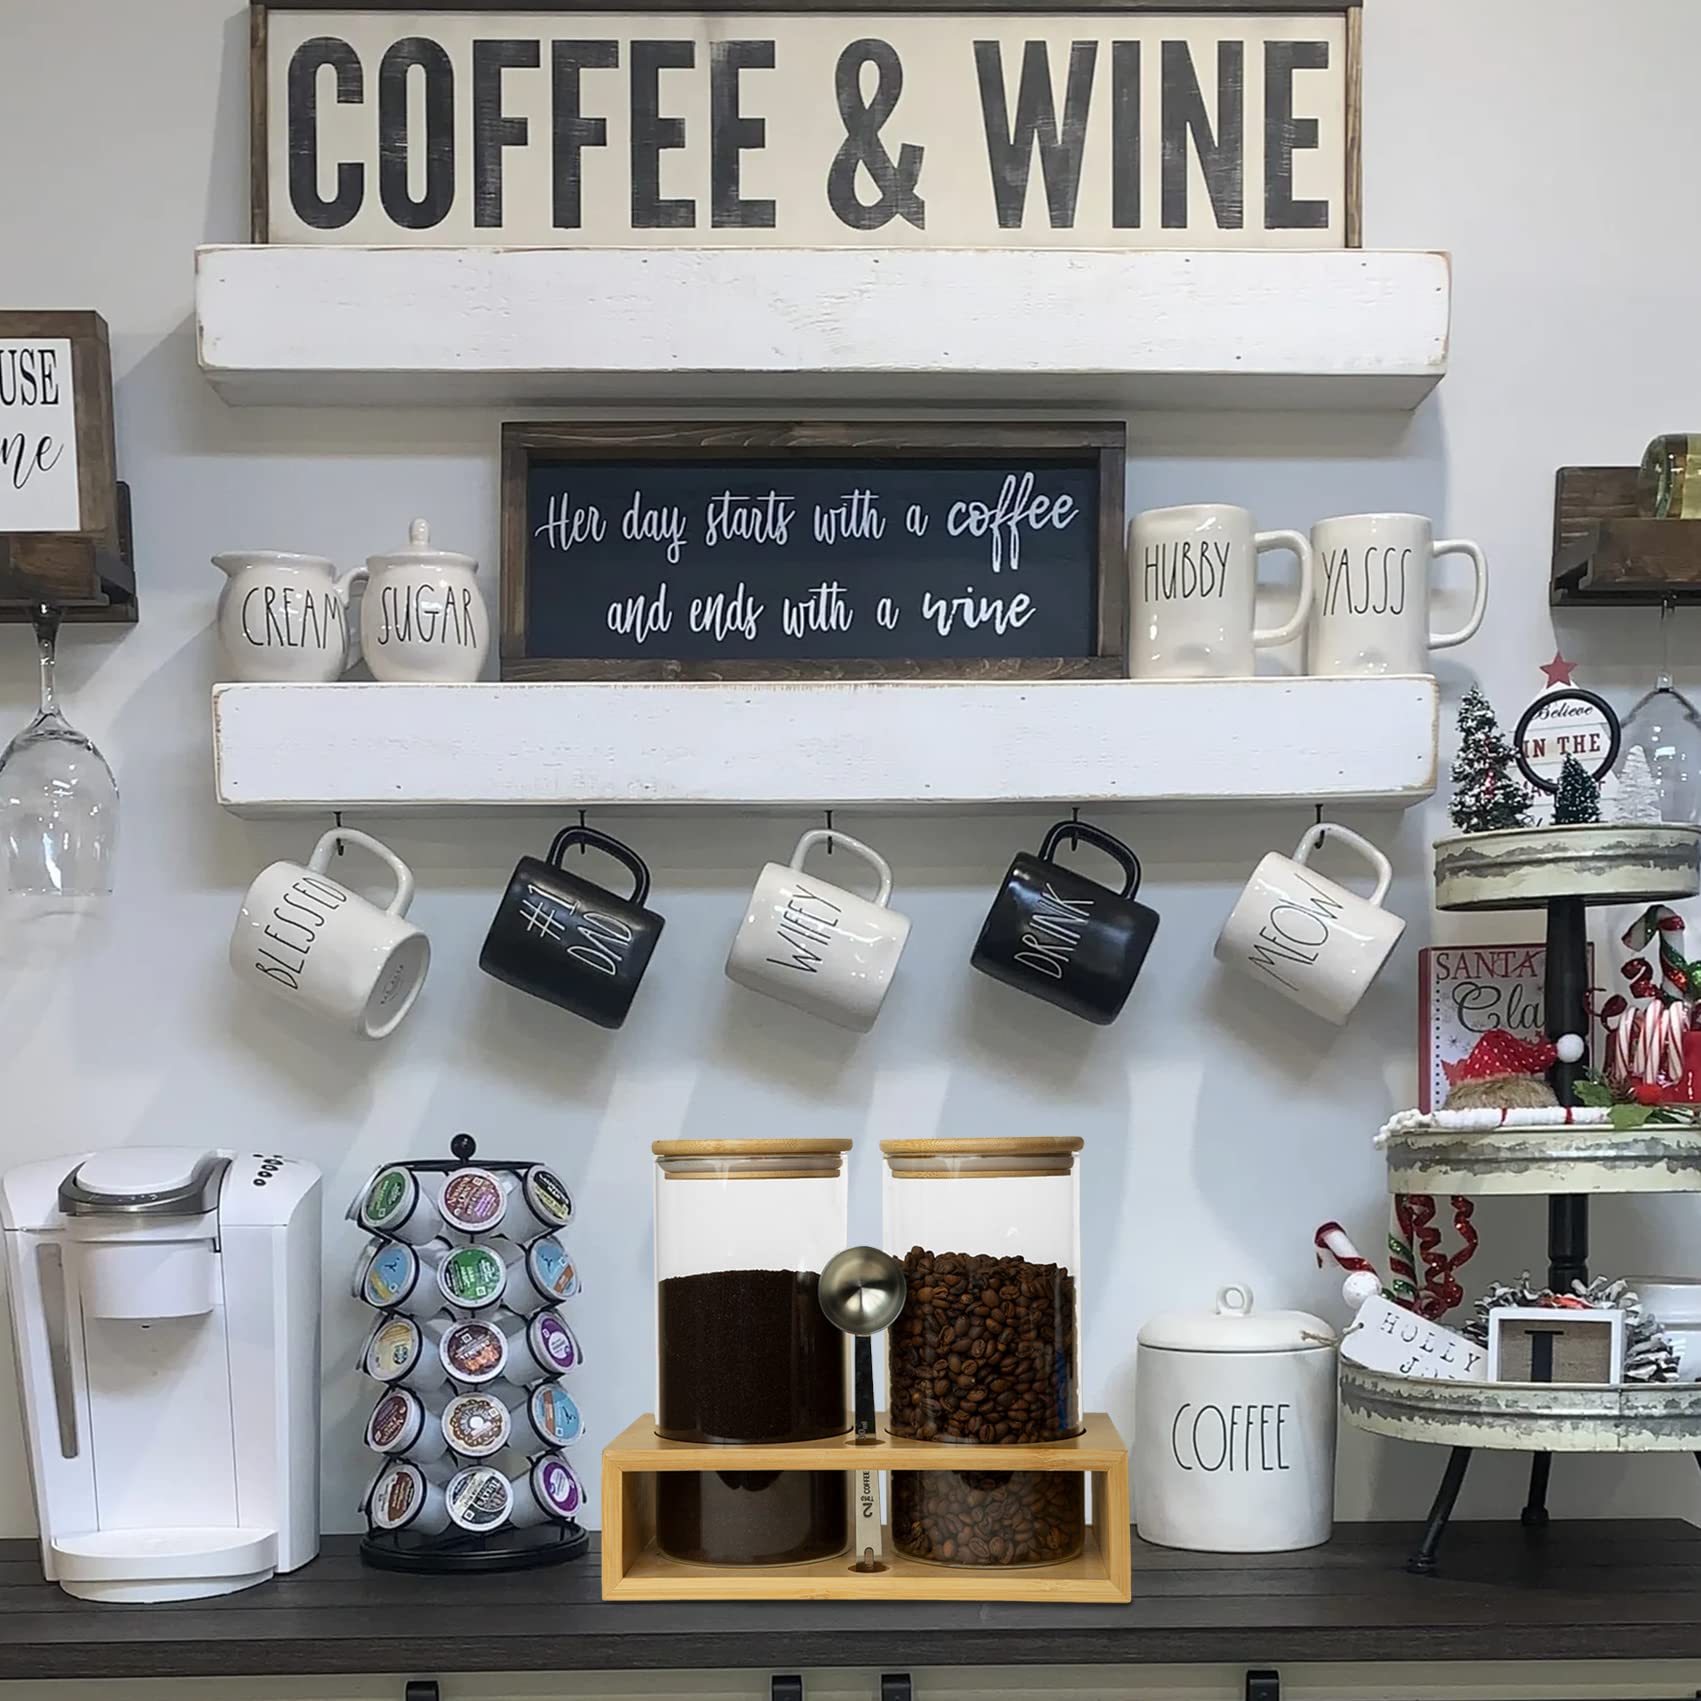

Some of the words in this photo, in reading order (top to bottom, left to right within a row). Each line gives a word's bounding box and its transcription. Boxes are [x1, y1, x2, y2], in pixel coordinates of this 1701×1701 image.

[287, 36, 776, 230] COFFEE
[827, 38, 926, 230] &
[973, 39, 1329, 230] WINE
[535, 492, 606, 551] Her
[622, 490, 687, 563] day
[705, 490, 796, 546] starts
[813, 489, 886, 544] with
[906, 504, 928, 536] a
[947, 471, 1079, 573] coffee
[1144, 540, 1230, 602] HUBBY
[1321, 546, 1412, 616] YASSS
[242, 586, 346, 653] CREAM
[377, 584, 477, 648] SUGAR
[607, 582, 672, 643] and
[689, 582, 764, 640] ends
[783, 581, 853, 638] with
[876, 597, 899, 629] a
[922, 587, 1036, 636] wine
[1532, 702, 1593, 720] Believe
[1523, 738, 1546, 758] IN
[1557, 733, 1600, 755] THE
[255, 876, 348, 990] BLESSED
[519, 884, 581, 942] #1
[567, 910, 633, 976] DAD
[766, 884, 843, 974] WIFEY
[1013, 882, 1095, 979] DRINK
[1248, 873, 1344, 991] MEOW
[1436, 951, 1541, 981] SANTA
[1452, 981, 1546, 1033] Cla
[1381, 1312, 1481, 1373] HOLLY
[1171, 1402, 1291, 1472] COFFEE
[862, 1502, 873, 1518] 2
